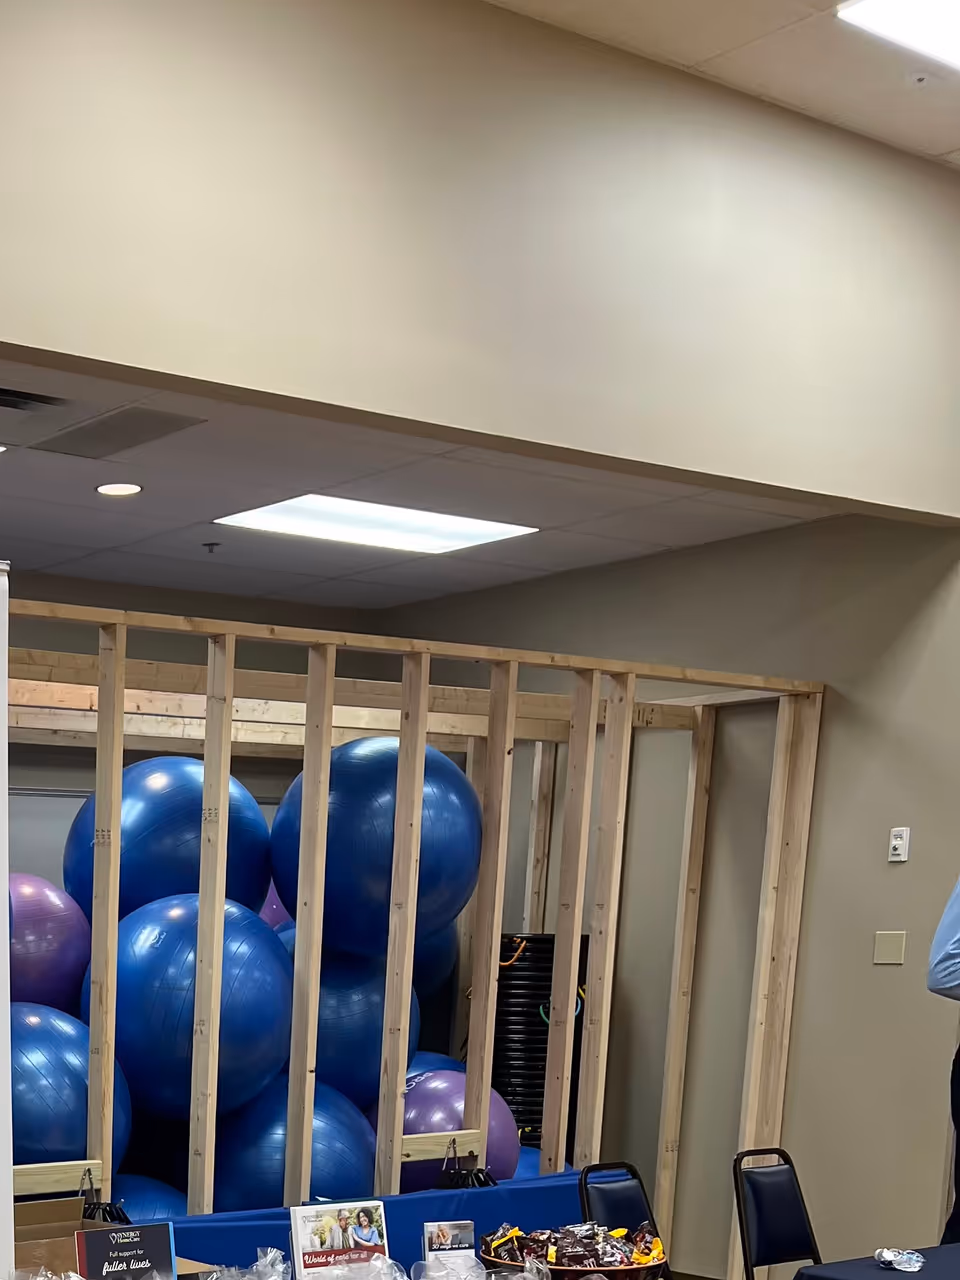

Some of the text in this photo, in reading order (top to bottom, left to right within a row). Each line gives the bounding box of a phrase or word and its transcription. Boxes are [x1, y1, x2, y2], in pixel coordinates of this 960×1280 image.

[304, 1255, 326, 1264] World
[102, 1259, 151, 1276] fuller lives
